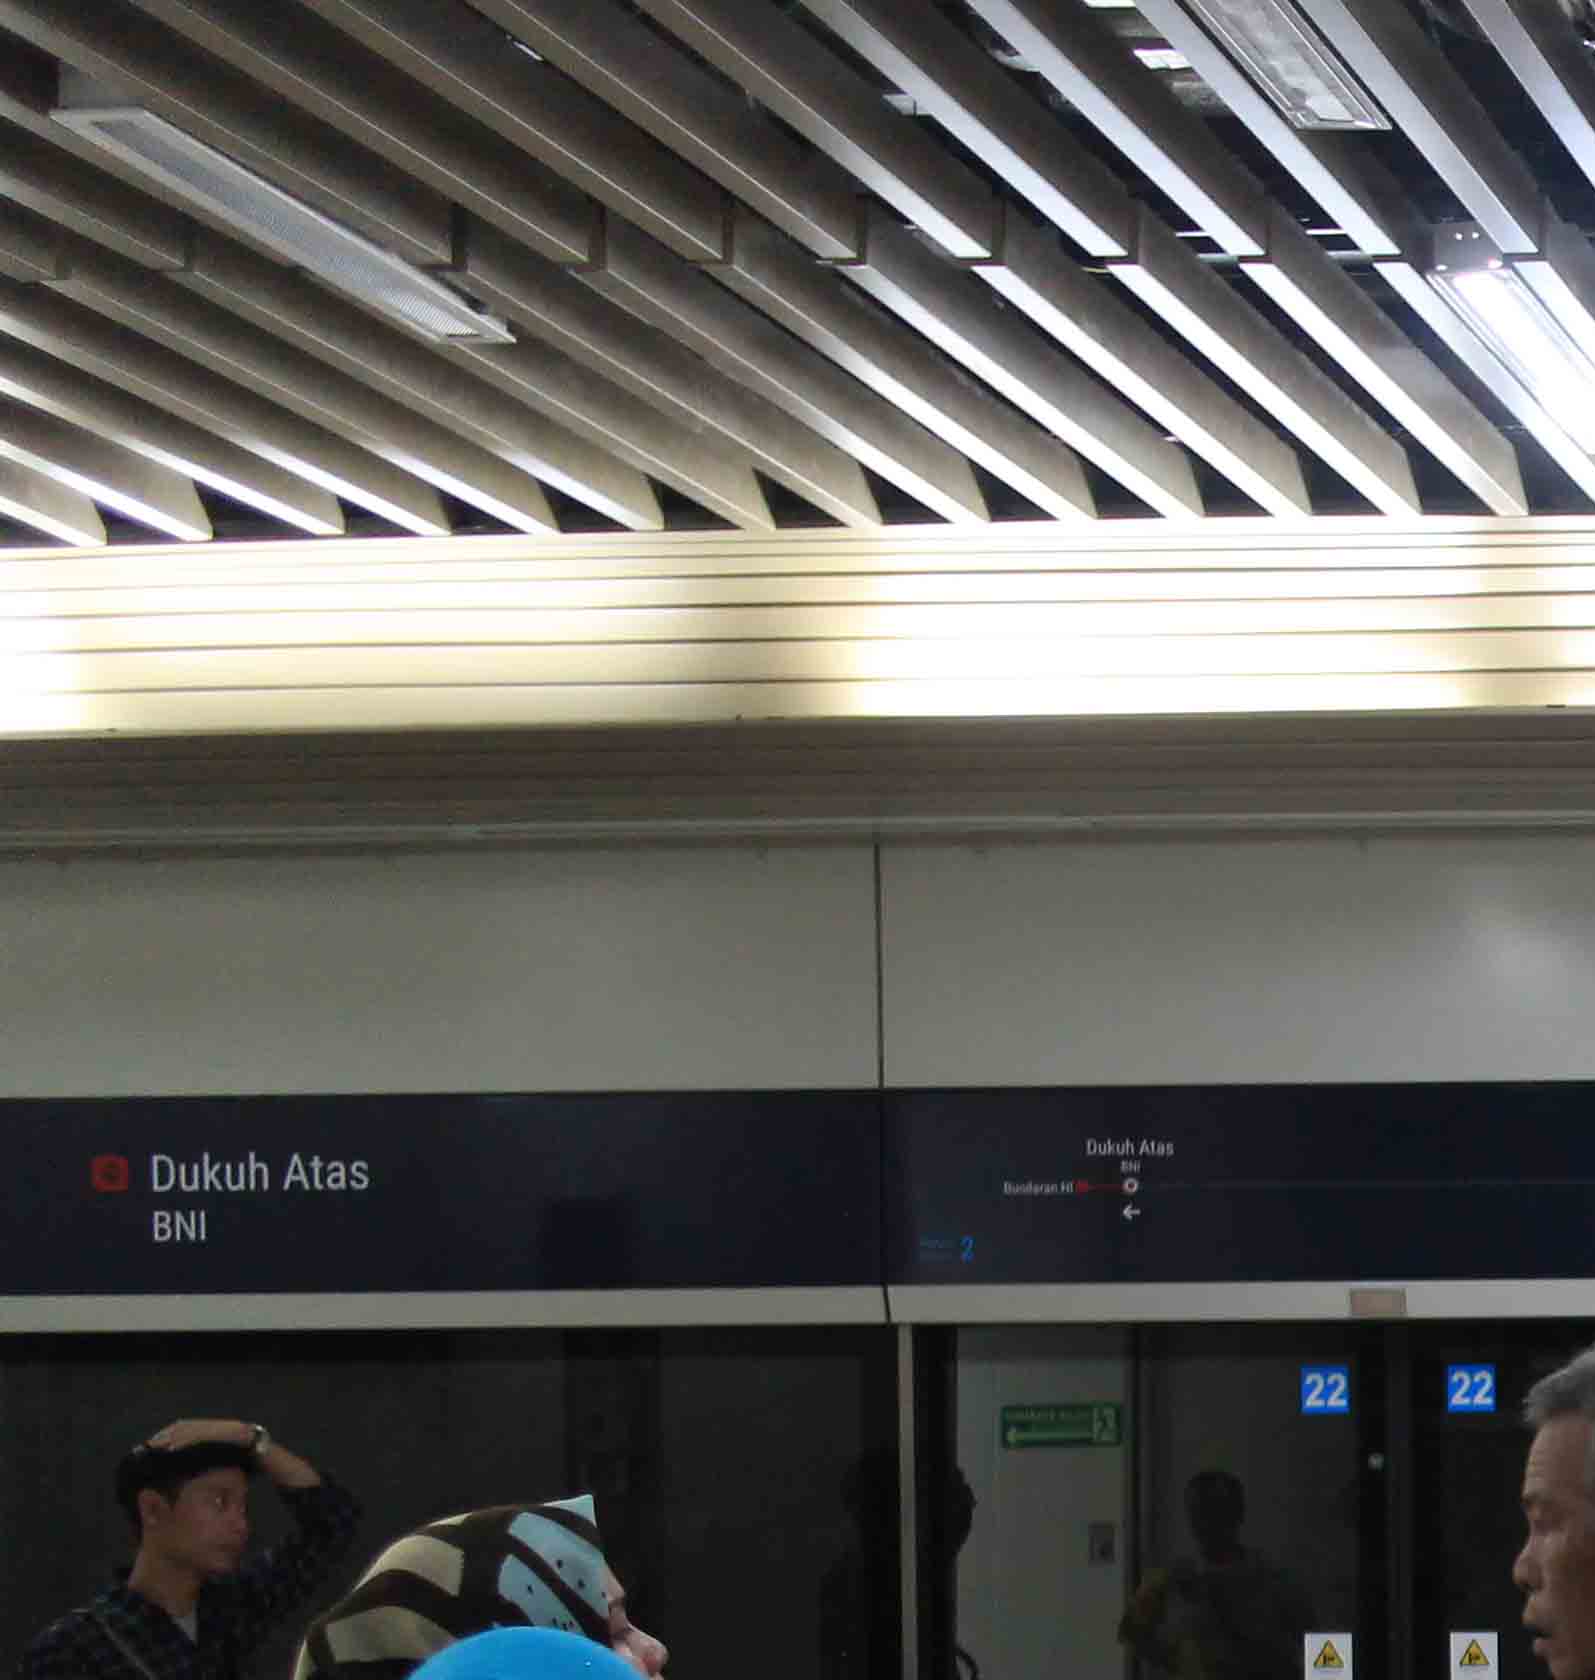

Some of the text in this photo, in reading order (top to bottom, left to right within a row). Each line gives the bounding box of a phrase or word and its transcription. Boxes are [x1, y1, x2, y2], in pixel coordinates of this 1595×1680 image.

[1087, 1139, 1173, 1155] Dukuh Atas
[153, 1152, 368, 1192] Dukuh Atas
[154, 1211, 205, 1241] BNI
[1306, 1374, 1346, 1407] 22
[1451, 1371, 1492, 1405] 22
